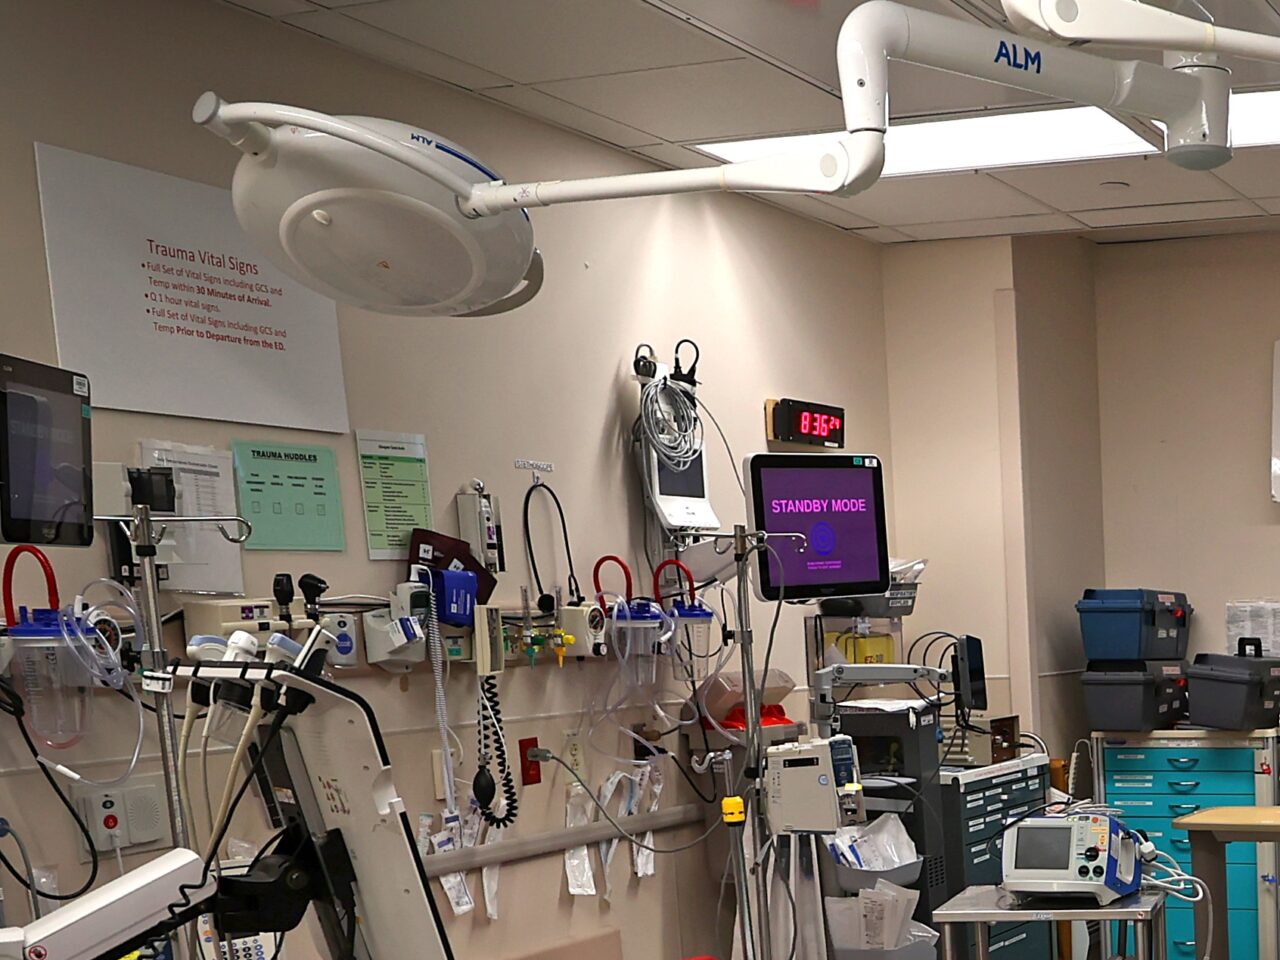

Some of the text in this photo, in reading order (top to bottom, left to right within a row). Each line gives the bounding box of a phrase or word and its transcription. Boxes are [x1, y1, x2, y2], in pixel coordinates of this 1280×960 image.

[994, 40, 1042, 74] ALM
[146, 239, 259, 276] Trauma Vital Signs
[147, 261, 283, 296] Full Set of Vital Signs including GCS and
[148, 276, 273, 307] Temp within 30 Minutes of Arrival.
[150, 292, 158, 302] Q
[164, 295, 182, 306] hour
[183, 297, 200, 309] vital
[201, 301, 221, 313] signs.
[152, 307, 287, 338] Full Set of Vital Signs including GCS and
[153, 321, 286, 351] Temp Prior to Departure from the ED.
[251, 449, 318, 463] TRAUMA HUDDLES
[772, 499, 867, 513] STANDBY MODE
